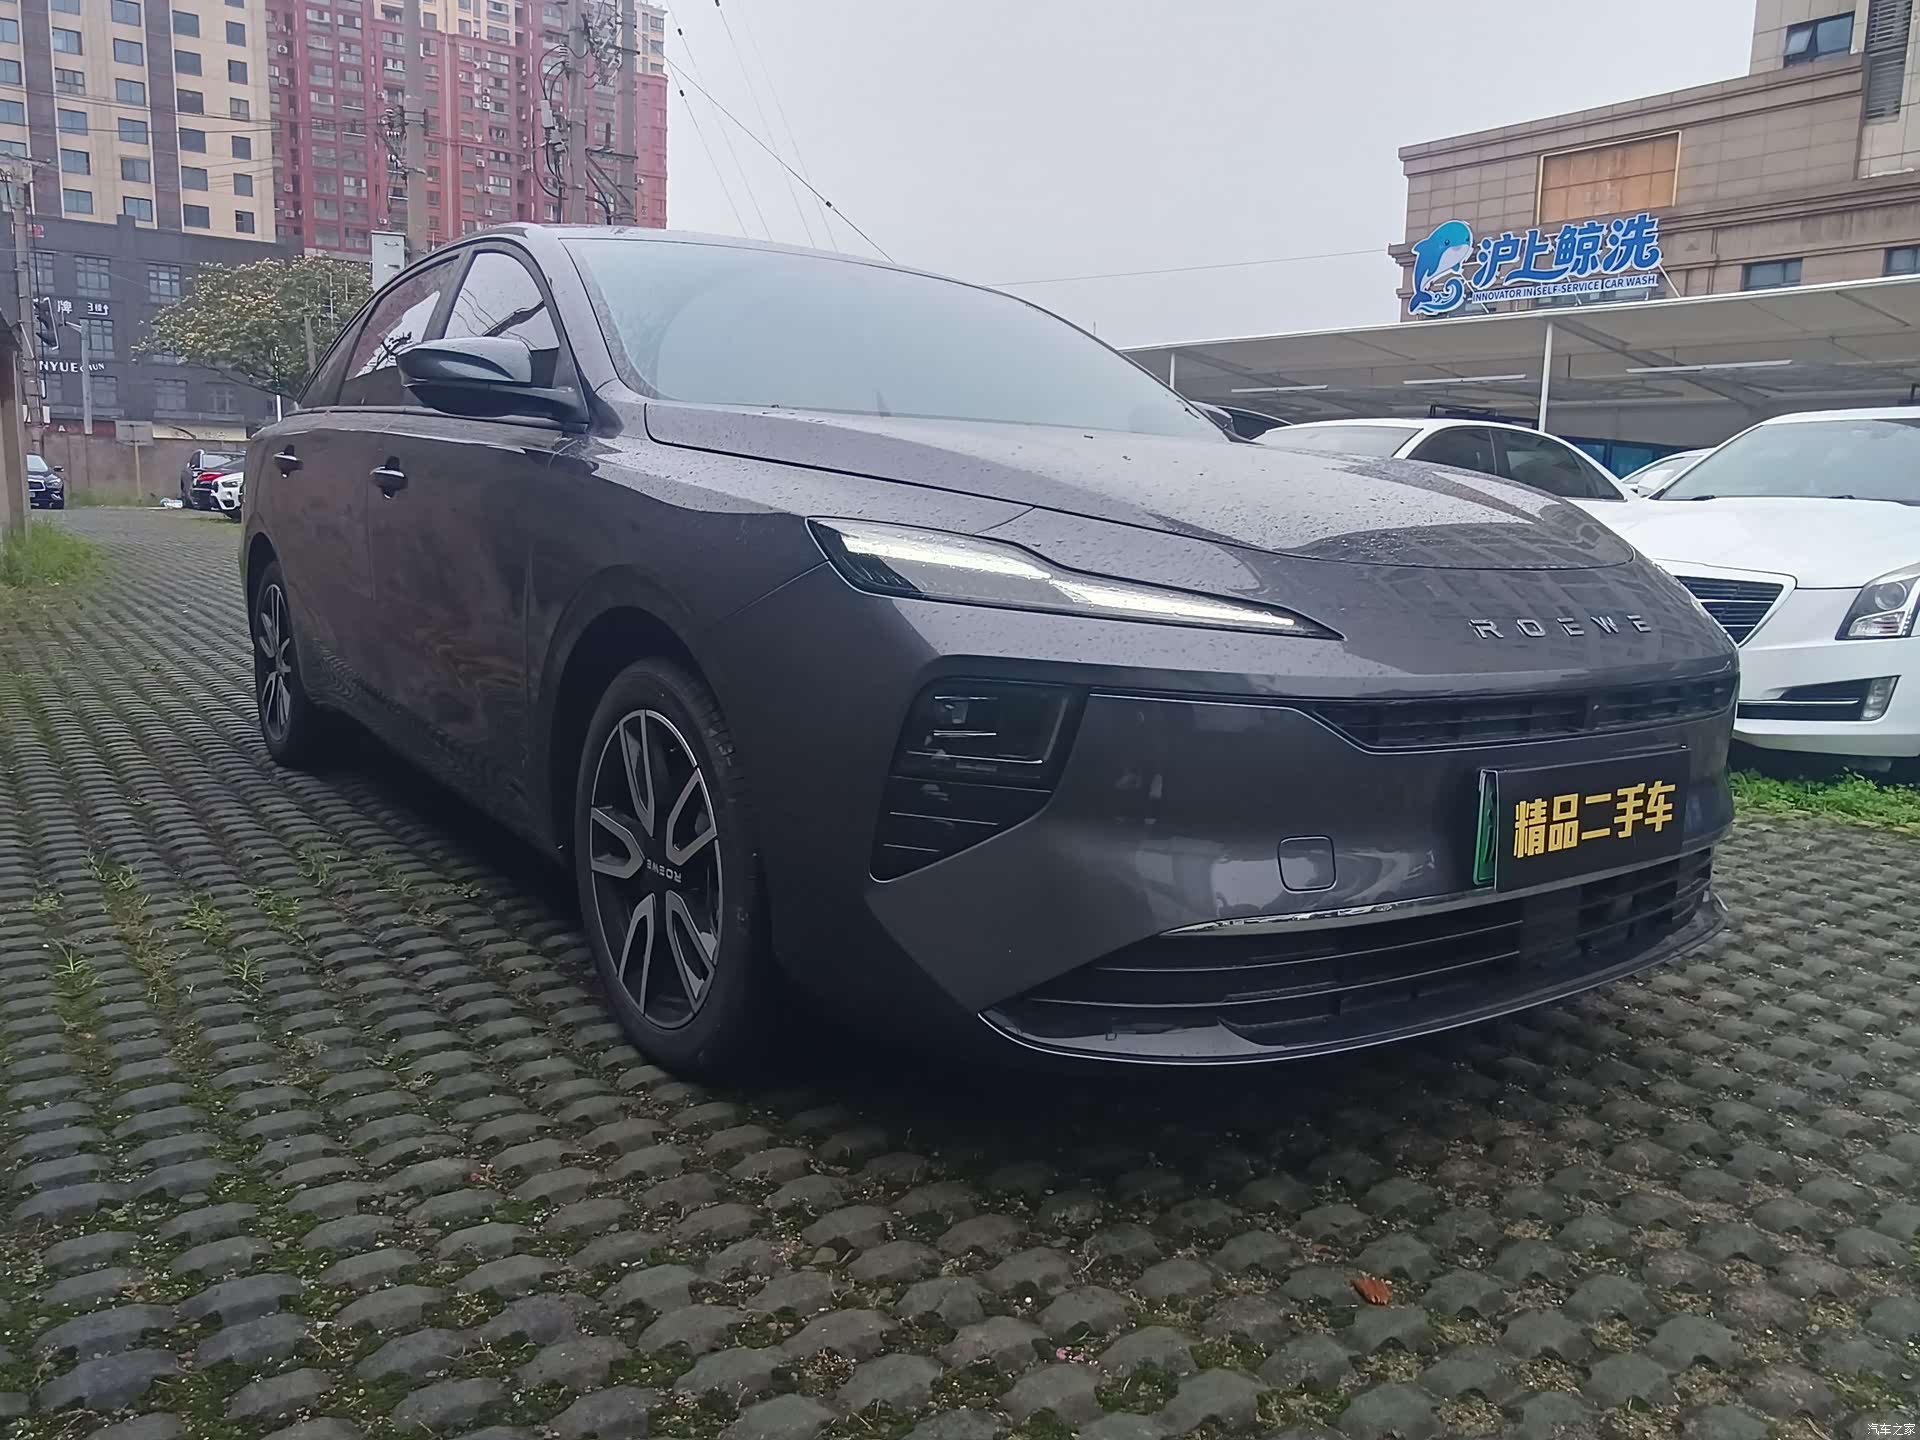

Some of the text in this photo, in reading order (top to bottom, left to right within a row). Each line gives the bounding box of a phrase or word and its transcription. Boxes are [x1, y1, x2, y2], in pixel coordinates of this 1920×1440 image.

[1471, 212, 1662, 290] 沪上鲸洗
[1473, 275, 1656, 302] INNOVATOR IN SELF-SERVICE CAR WASH
[1468, 614, 1651, 639] ROEWE
[1513, 780, 1676, 859] 精品二手车
[646, 858, 682, 884] ROEWE
